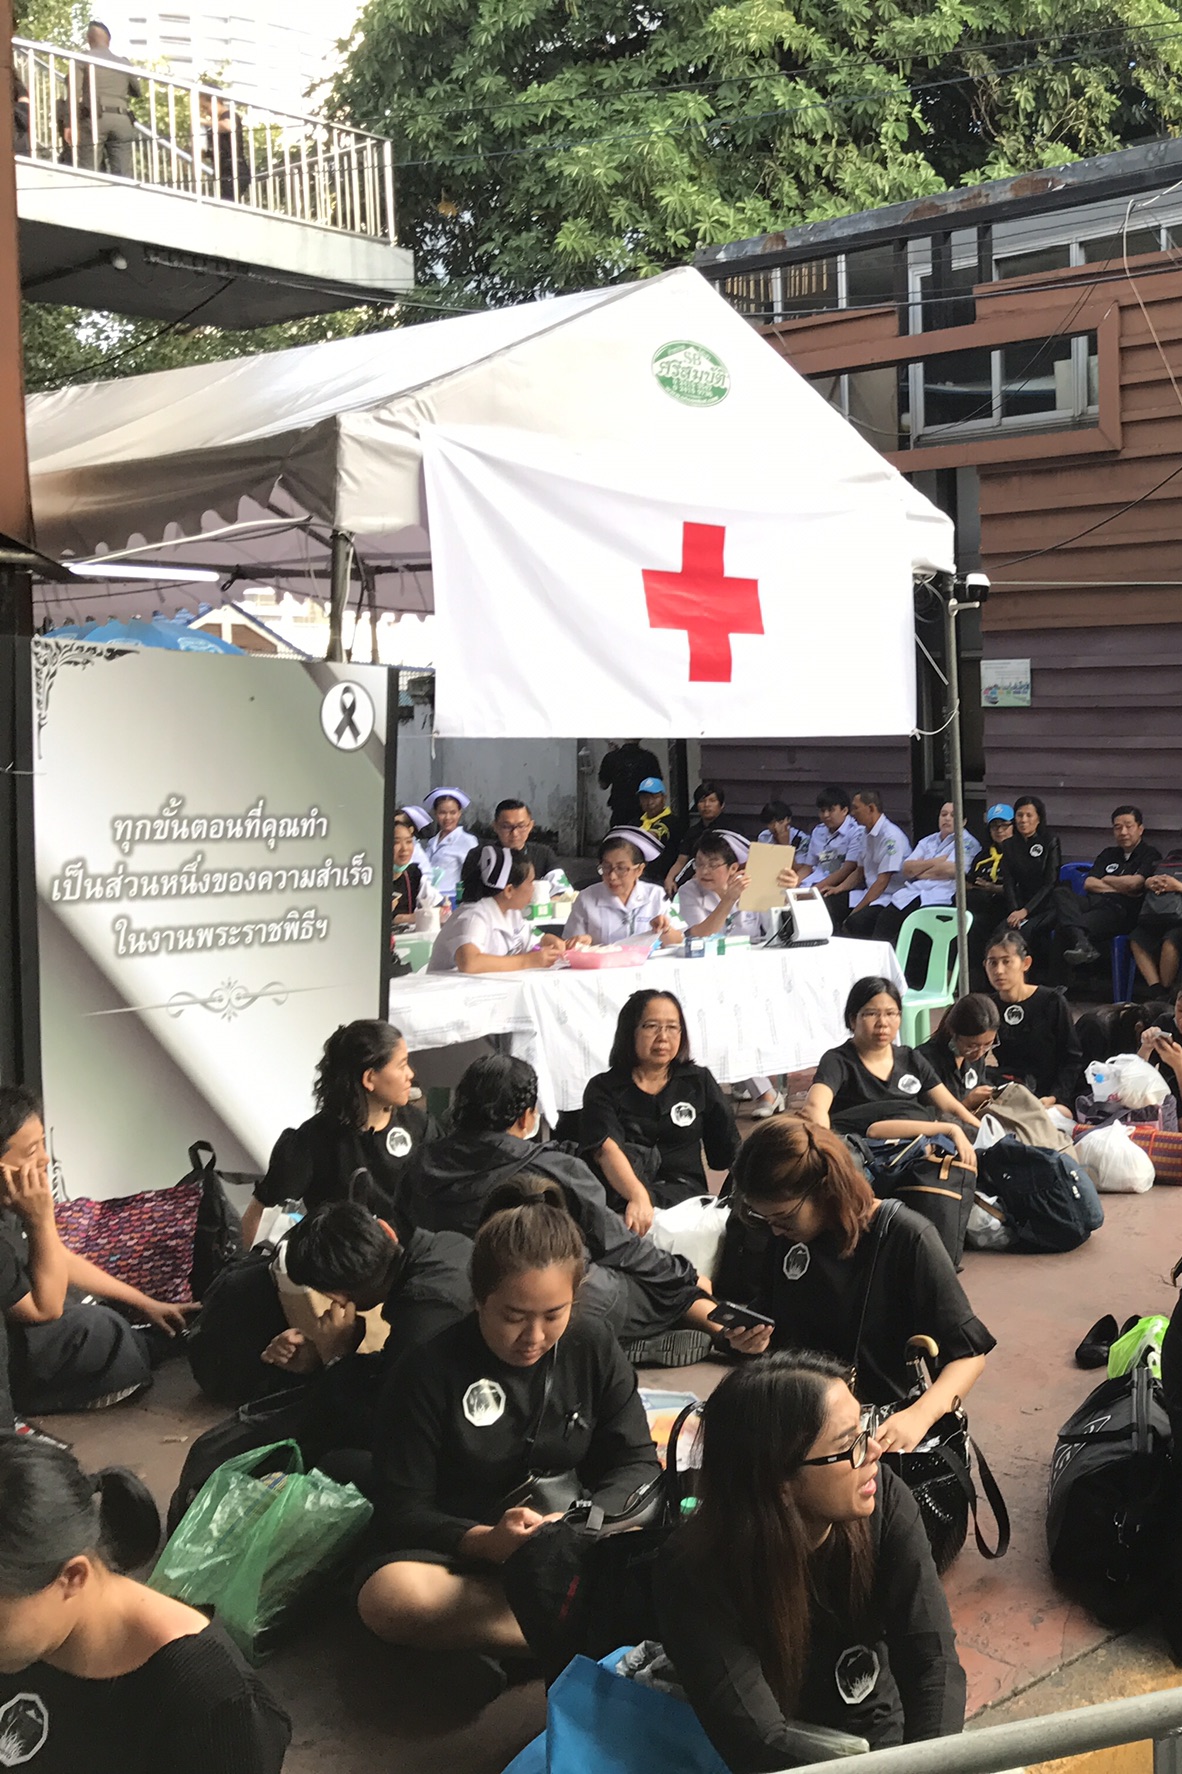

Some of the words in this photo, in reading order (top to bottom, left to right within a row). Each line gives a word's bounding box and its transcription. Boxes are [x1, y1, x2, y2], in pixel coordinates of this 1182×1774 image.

[112, 796, 329, 853] ทุกขั้นตอนที่คุณทำ
[51, 851, 374, 902] เป็นส่วนหนึ่งของความสำเร็จ
[112, 907, 329, 955] ในงานพระราชพิธีฯ
